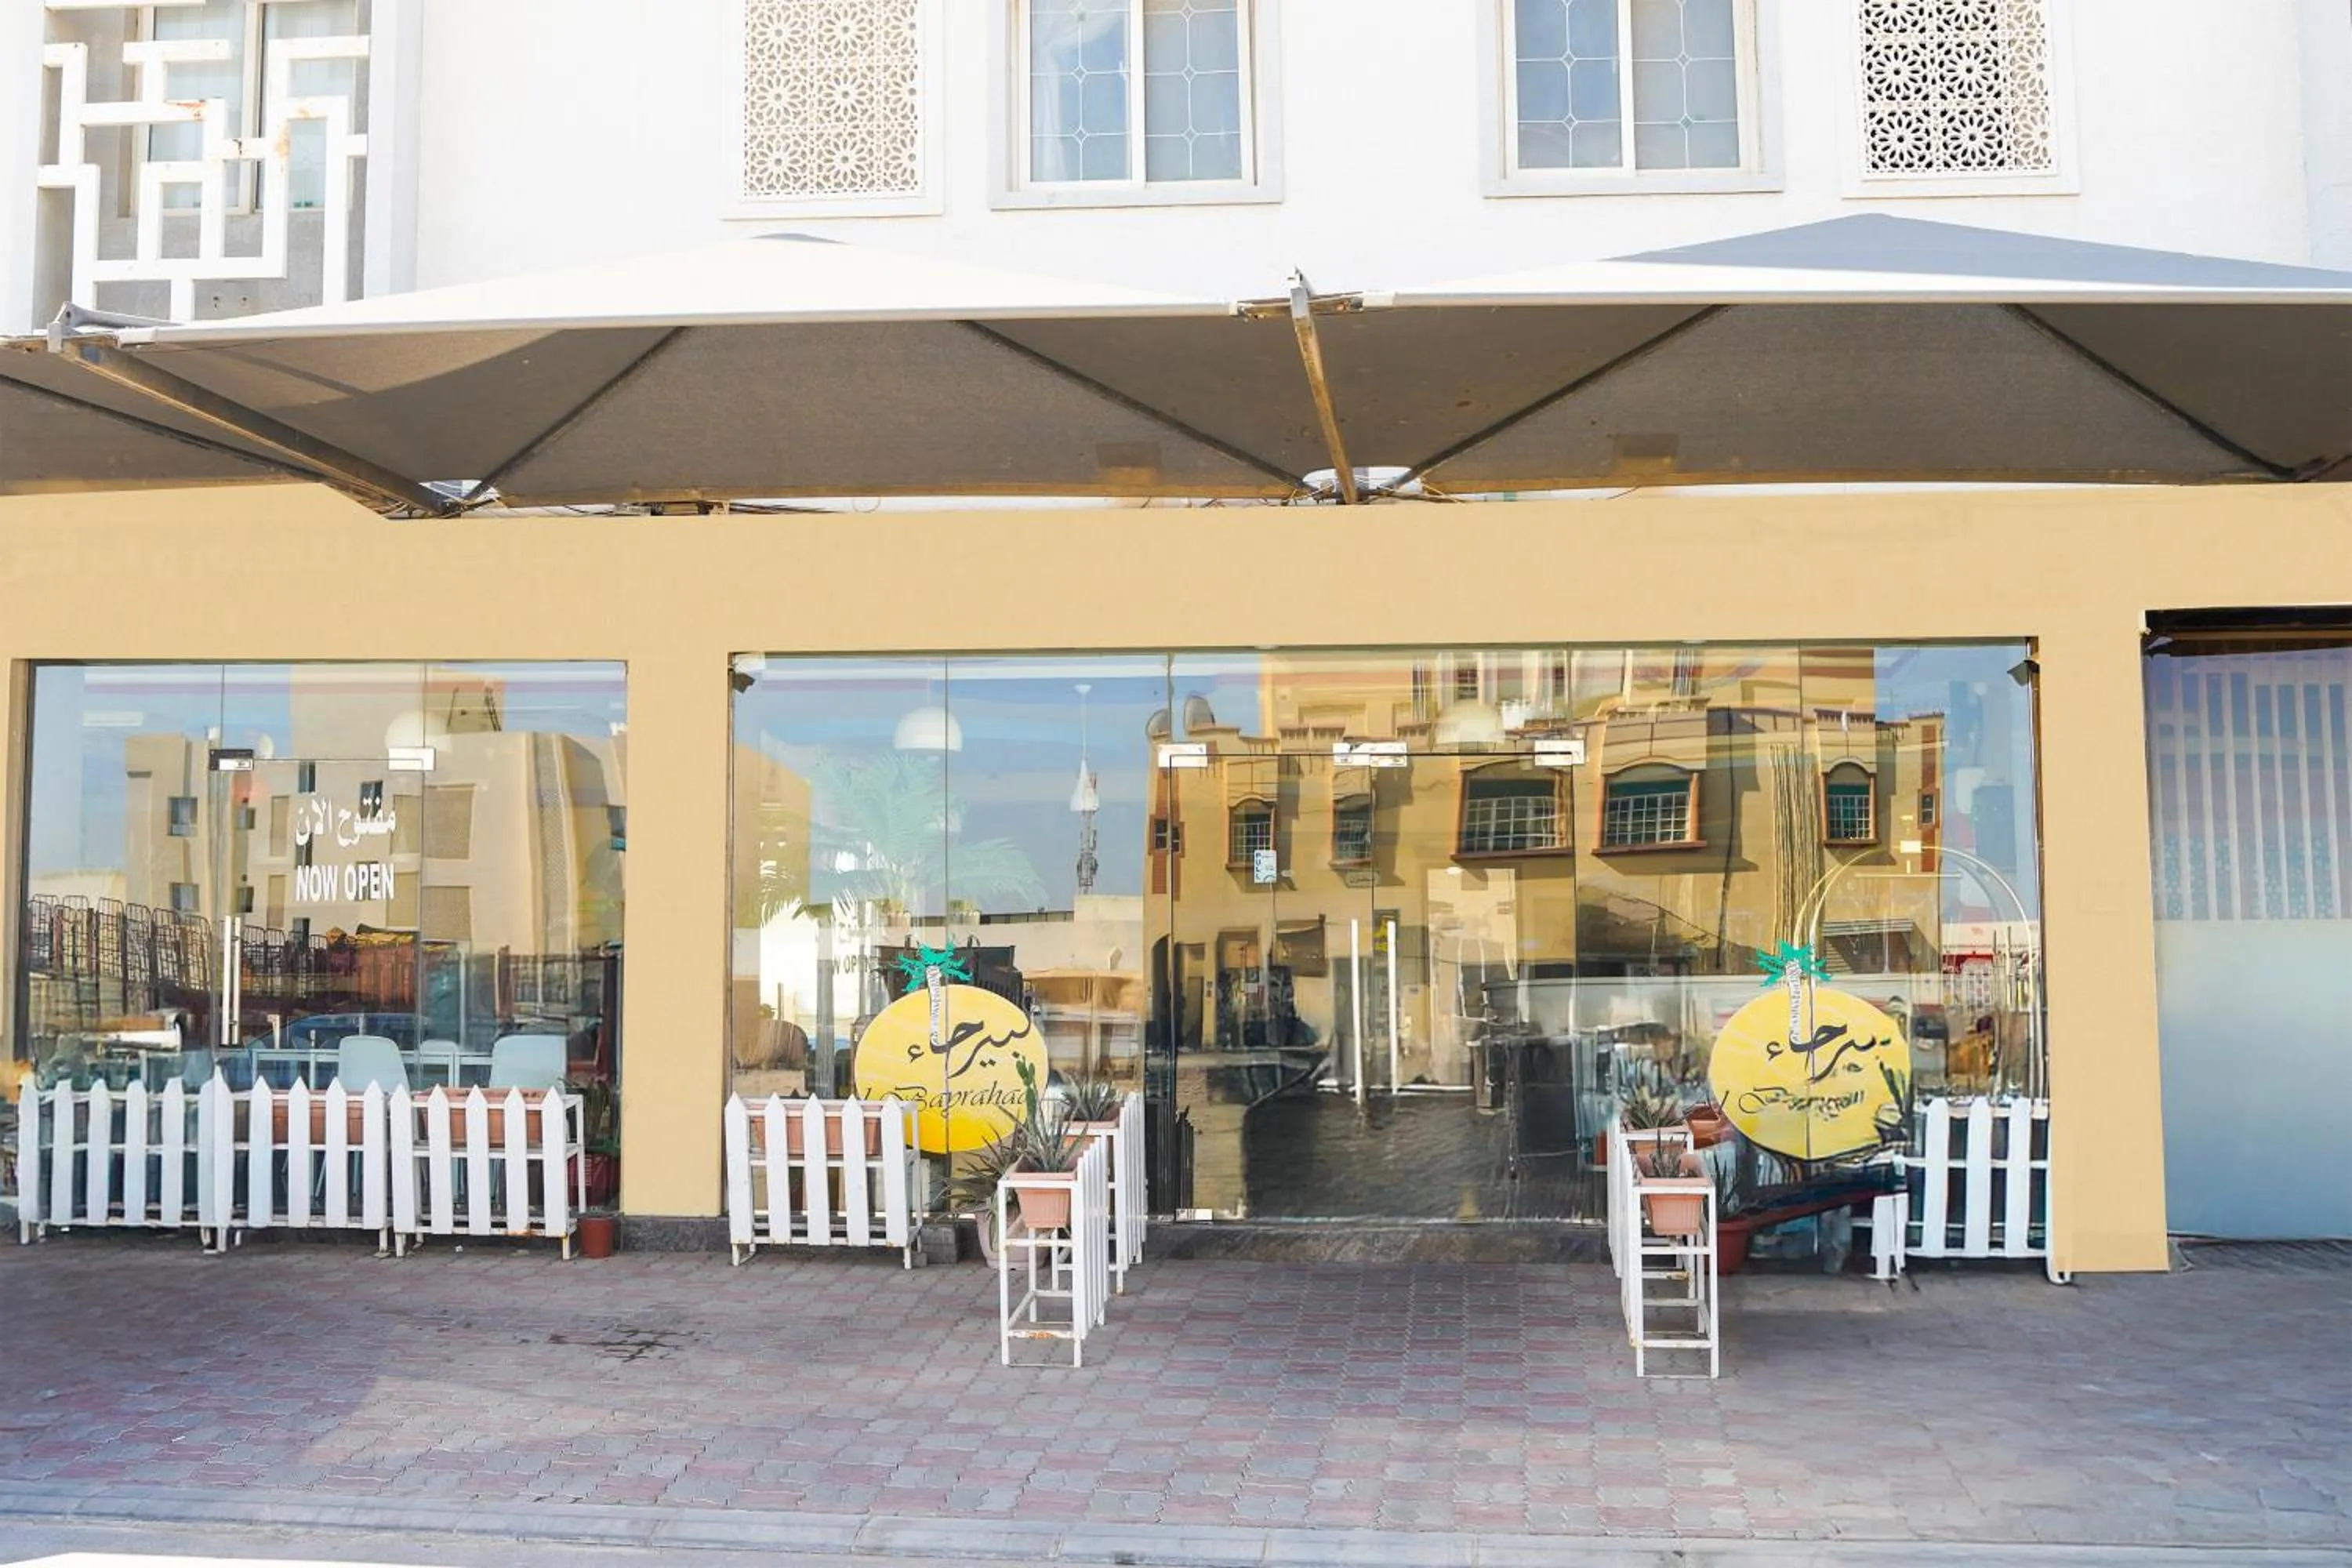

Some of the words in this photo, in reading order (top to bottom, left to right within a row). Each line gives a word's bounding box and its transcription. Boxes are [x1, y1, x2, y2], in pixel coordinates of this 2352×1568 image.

[336, 796, 396, 848] مفتوح
[296, 864, 339, 902] NOW
[344, 863, 394, 902] OPEN
